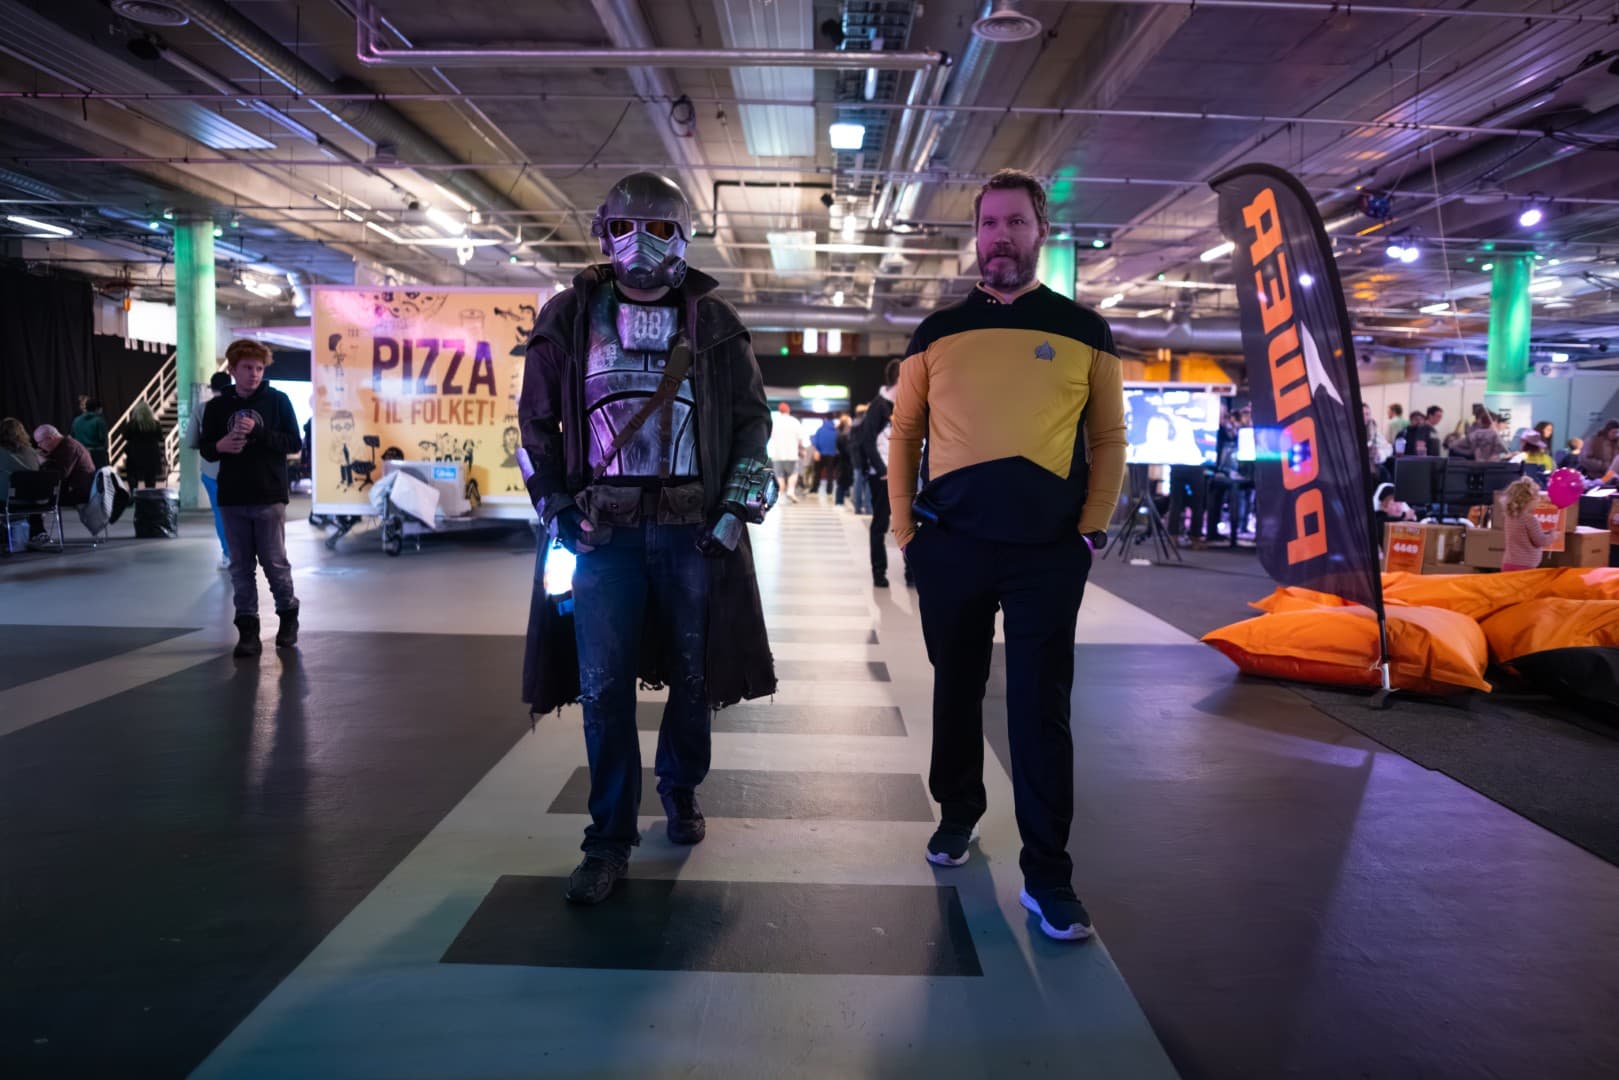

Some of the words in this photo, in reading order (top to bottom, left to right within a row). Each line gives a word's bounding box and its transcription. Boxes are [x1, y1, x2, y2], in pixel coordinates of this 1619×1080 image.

[372, 336, 497, 397] PIZZA
[371, 397, 402, 424] TIL
[411, 398, 496, 426] FOLKET!
